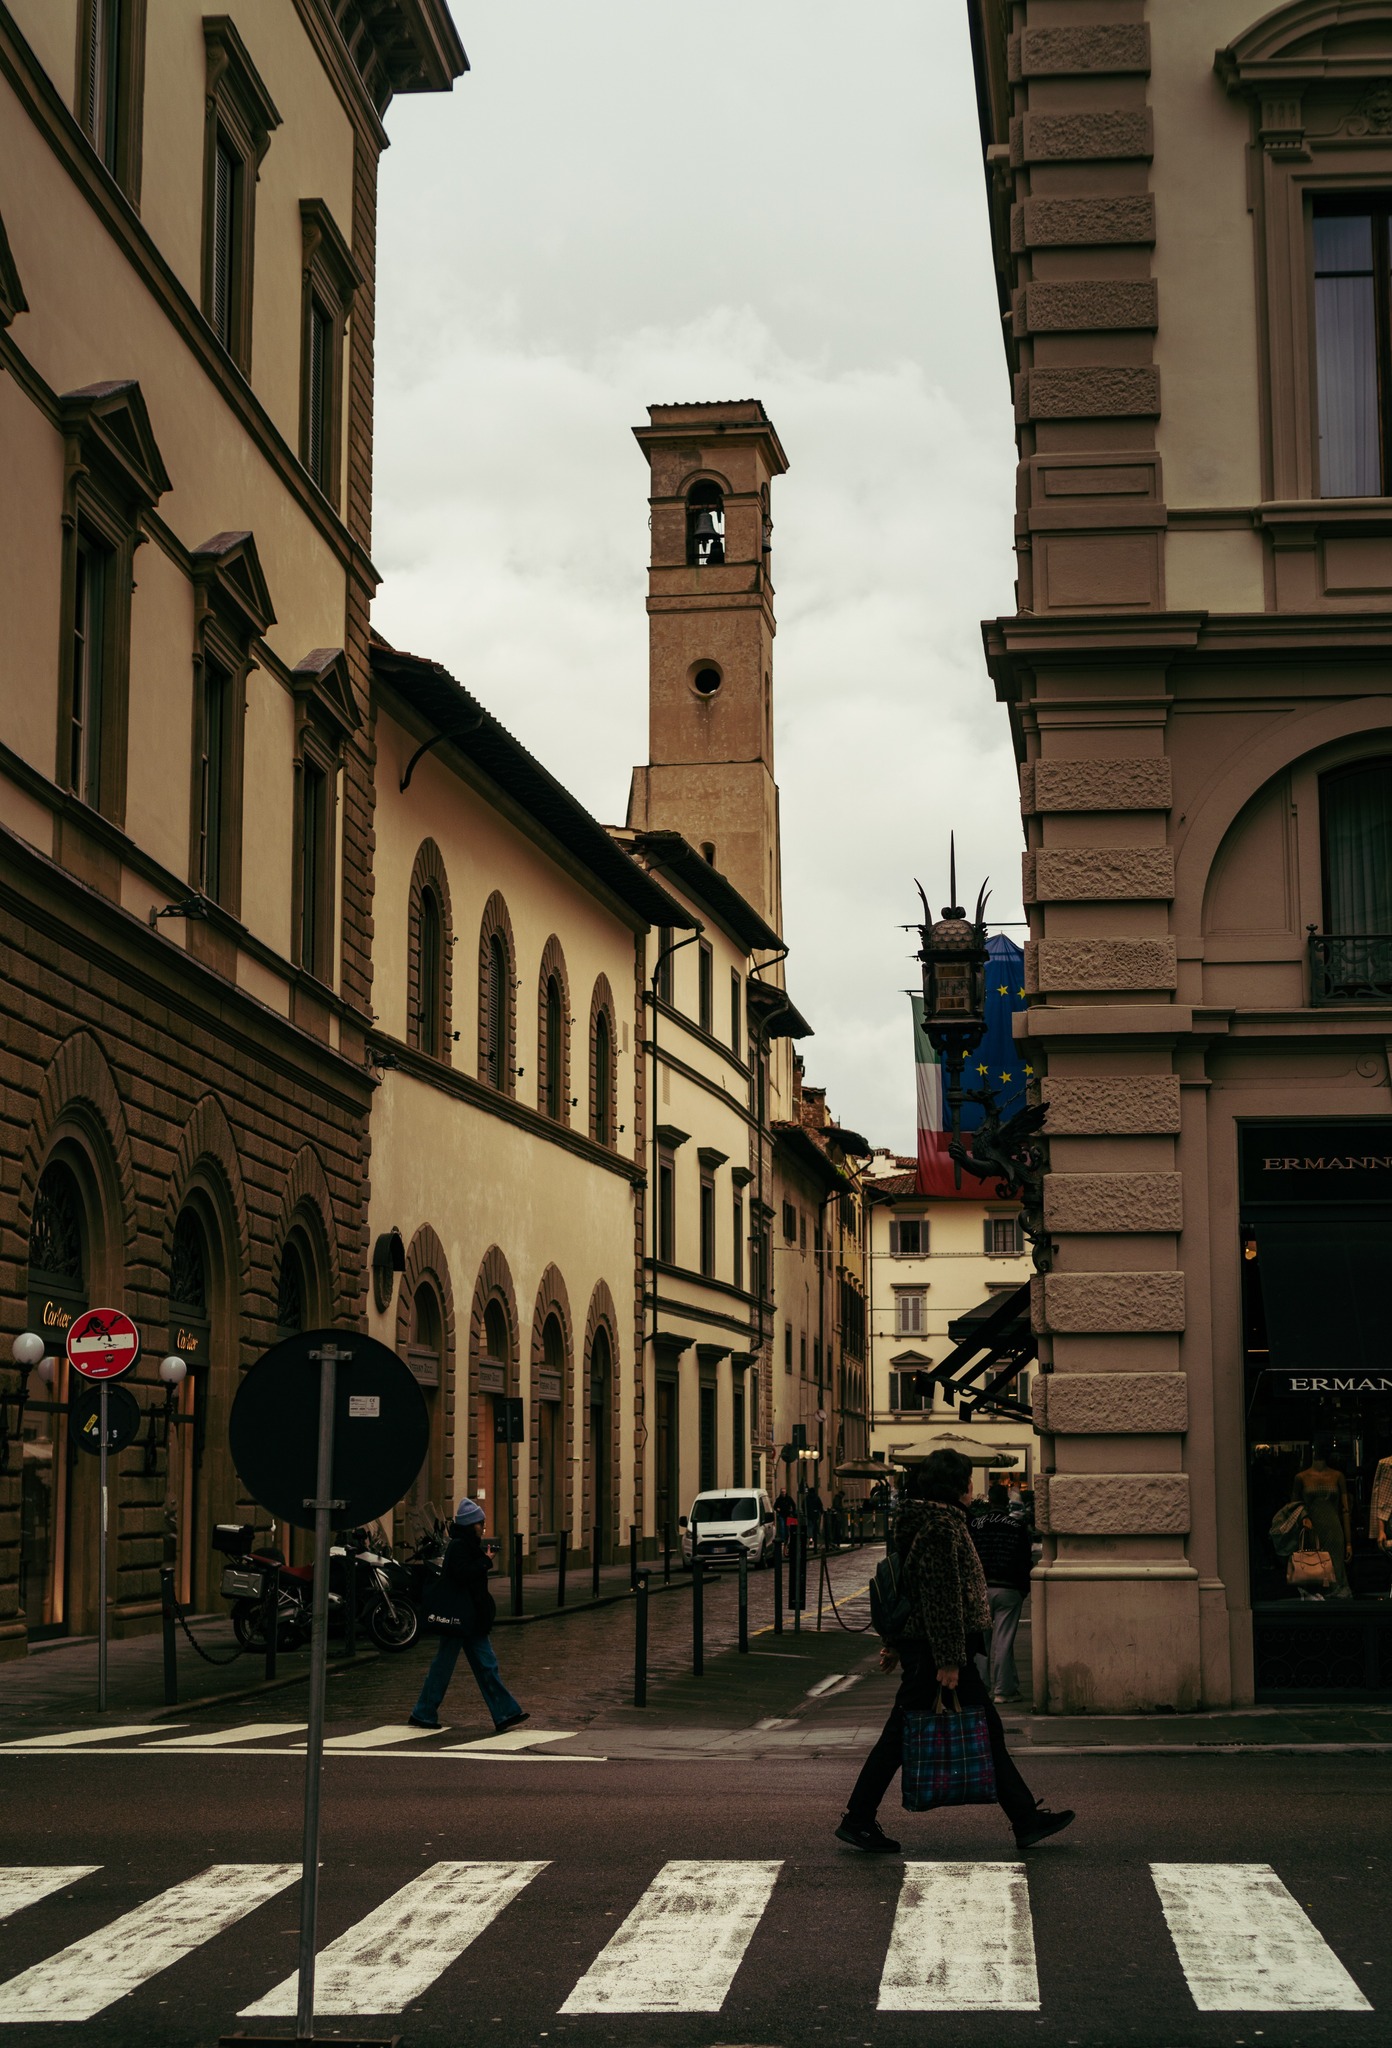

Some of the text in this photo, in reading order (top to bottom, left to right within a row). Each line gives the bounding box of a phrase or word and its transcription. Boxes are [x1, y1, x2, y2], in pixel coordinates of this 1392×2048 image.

[1261, 1156, 1392, 1171] ERMANN
[43, 1300, 72, 1329] Cartier
[176, 1328, 199, 1351] Cartier
